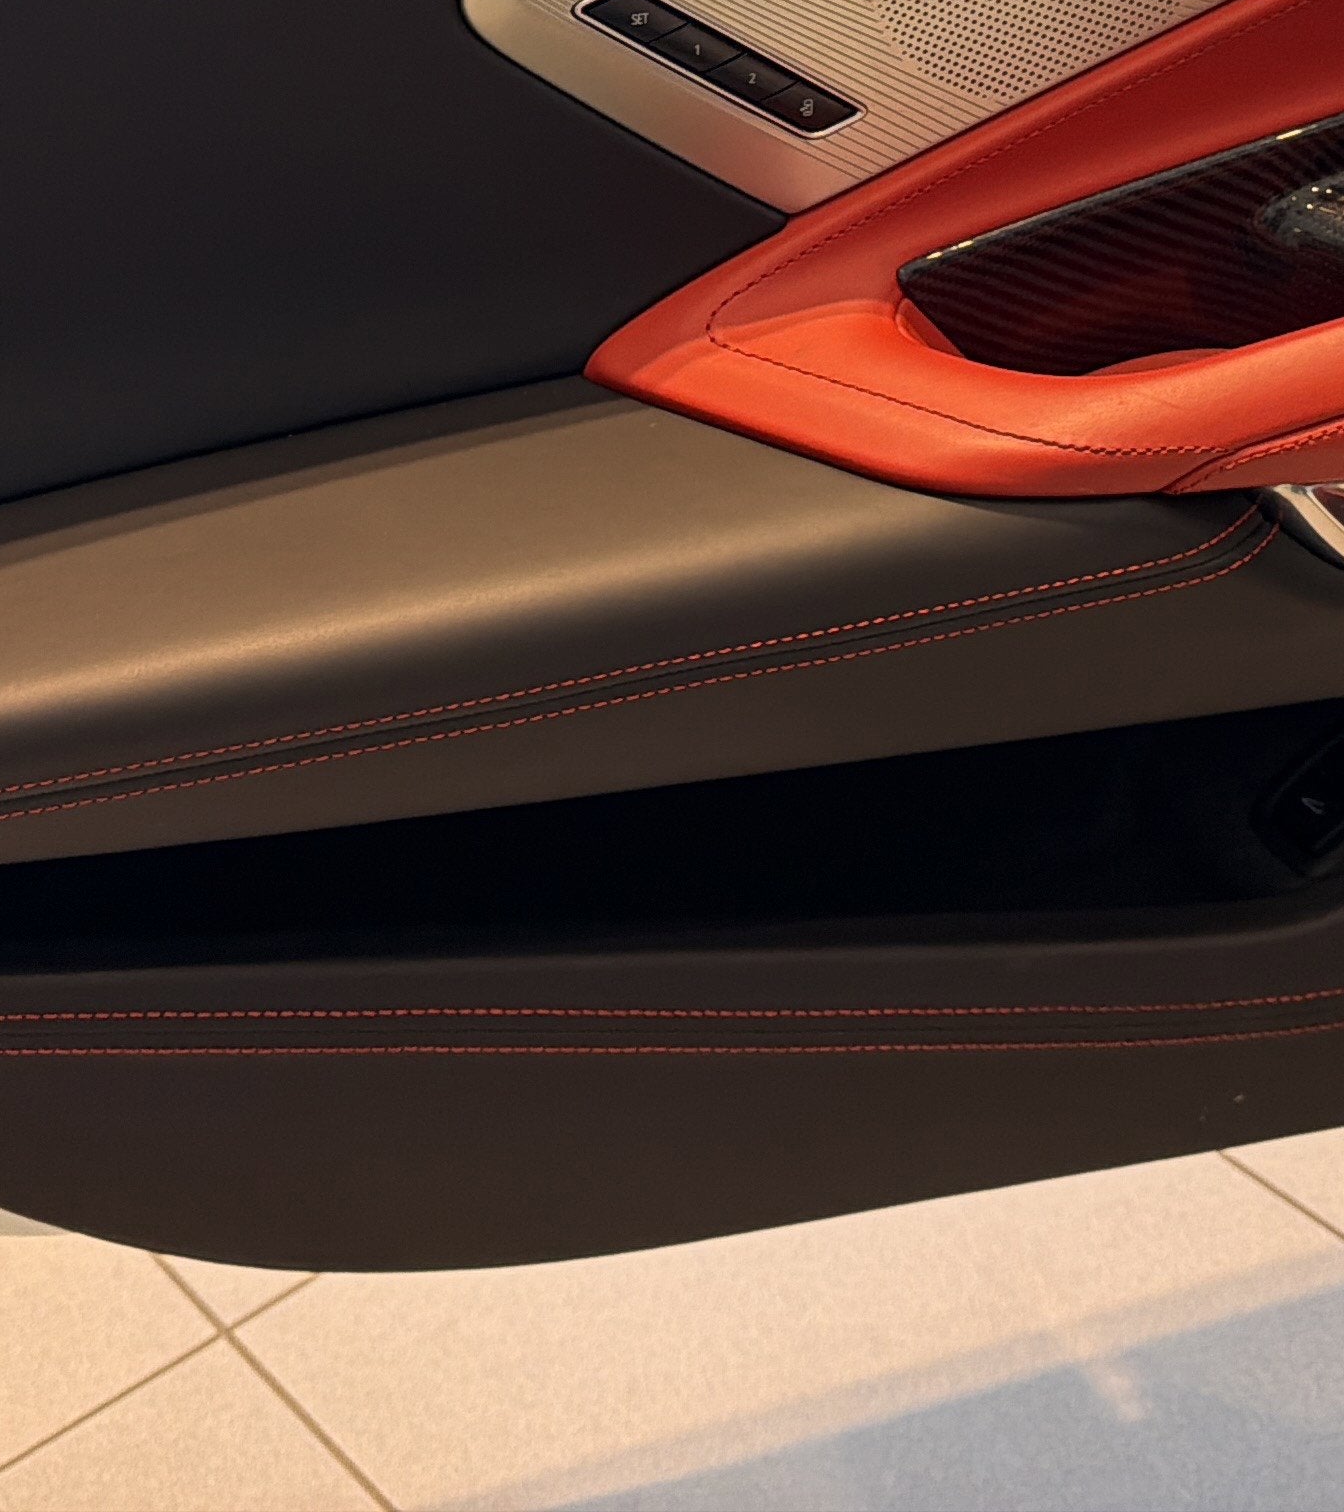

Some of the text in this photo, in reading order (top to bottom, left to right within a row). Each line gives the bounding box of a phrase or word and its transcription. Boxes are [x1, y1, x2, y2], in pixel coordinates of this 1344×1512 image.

[630, 12, 649, 26] SET
[694, 44, 701, 56] 1
[748, 72, 757, 85] 2
